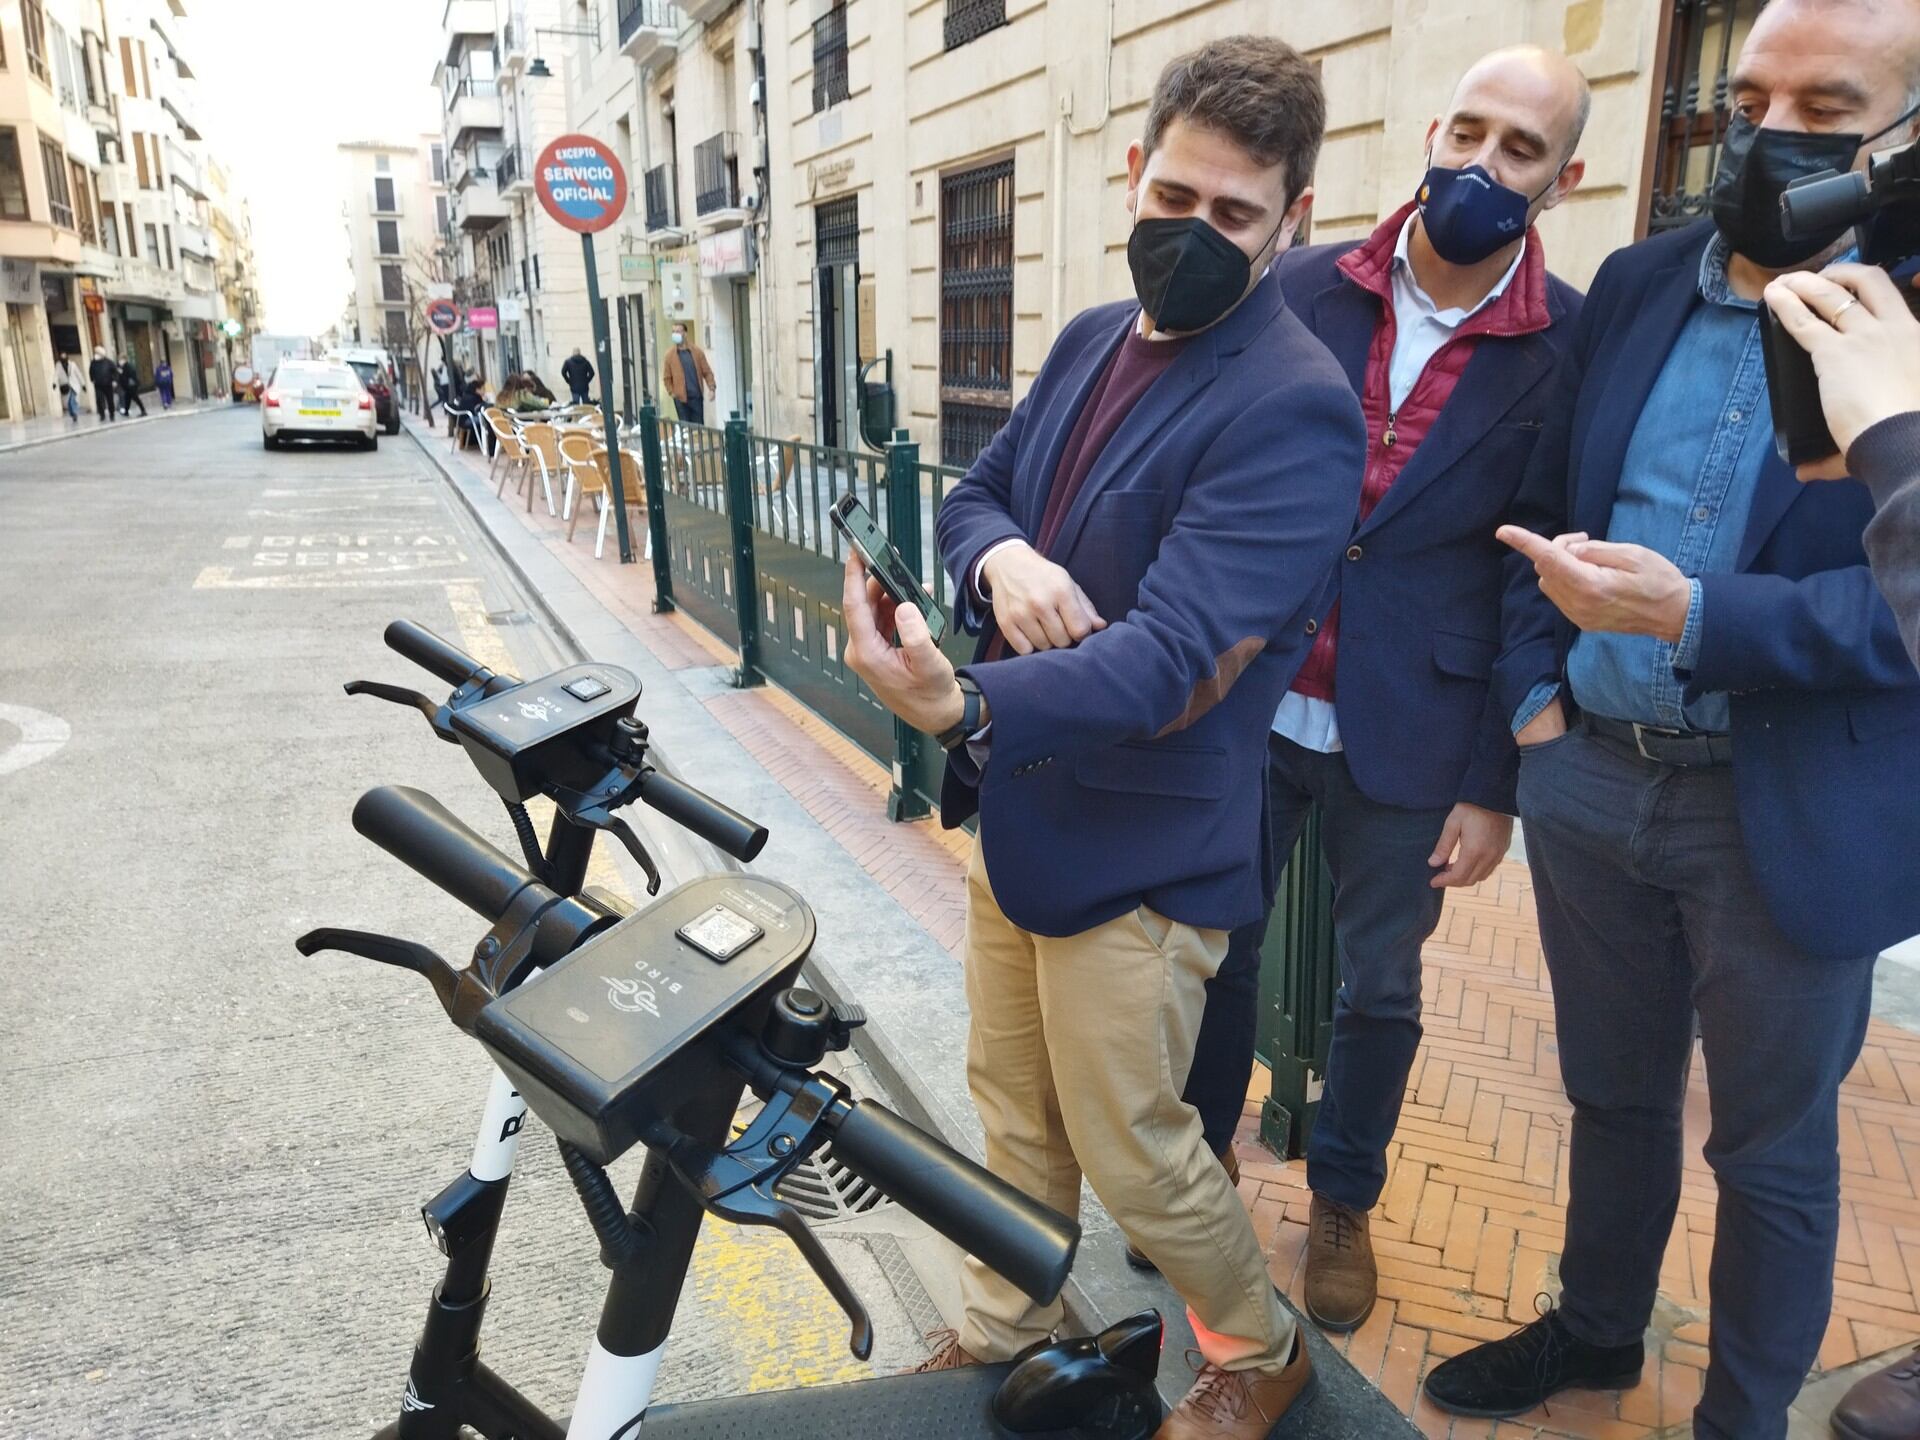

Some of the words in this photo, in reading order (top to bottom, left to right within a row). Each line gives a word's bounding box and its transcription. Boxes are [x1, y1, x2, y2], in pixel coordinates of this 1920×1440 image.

[555, 147, 596, 160] EXCEPTO
[544, 166, 613, 181] SERVICIO
[552, 187, 611, 201] OFICIAL
[635, 961, 683, 994] BIRD
